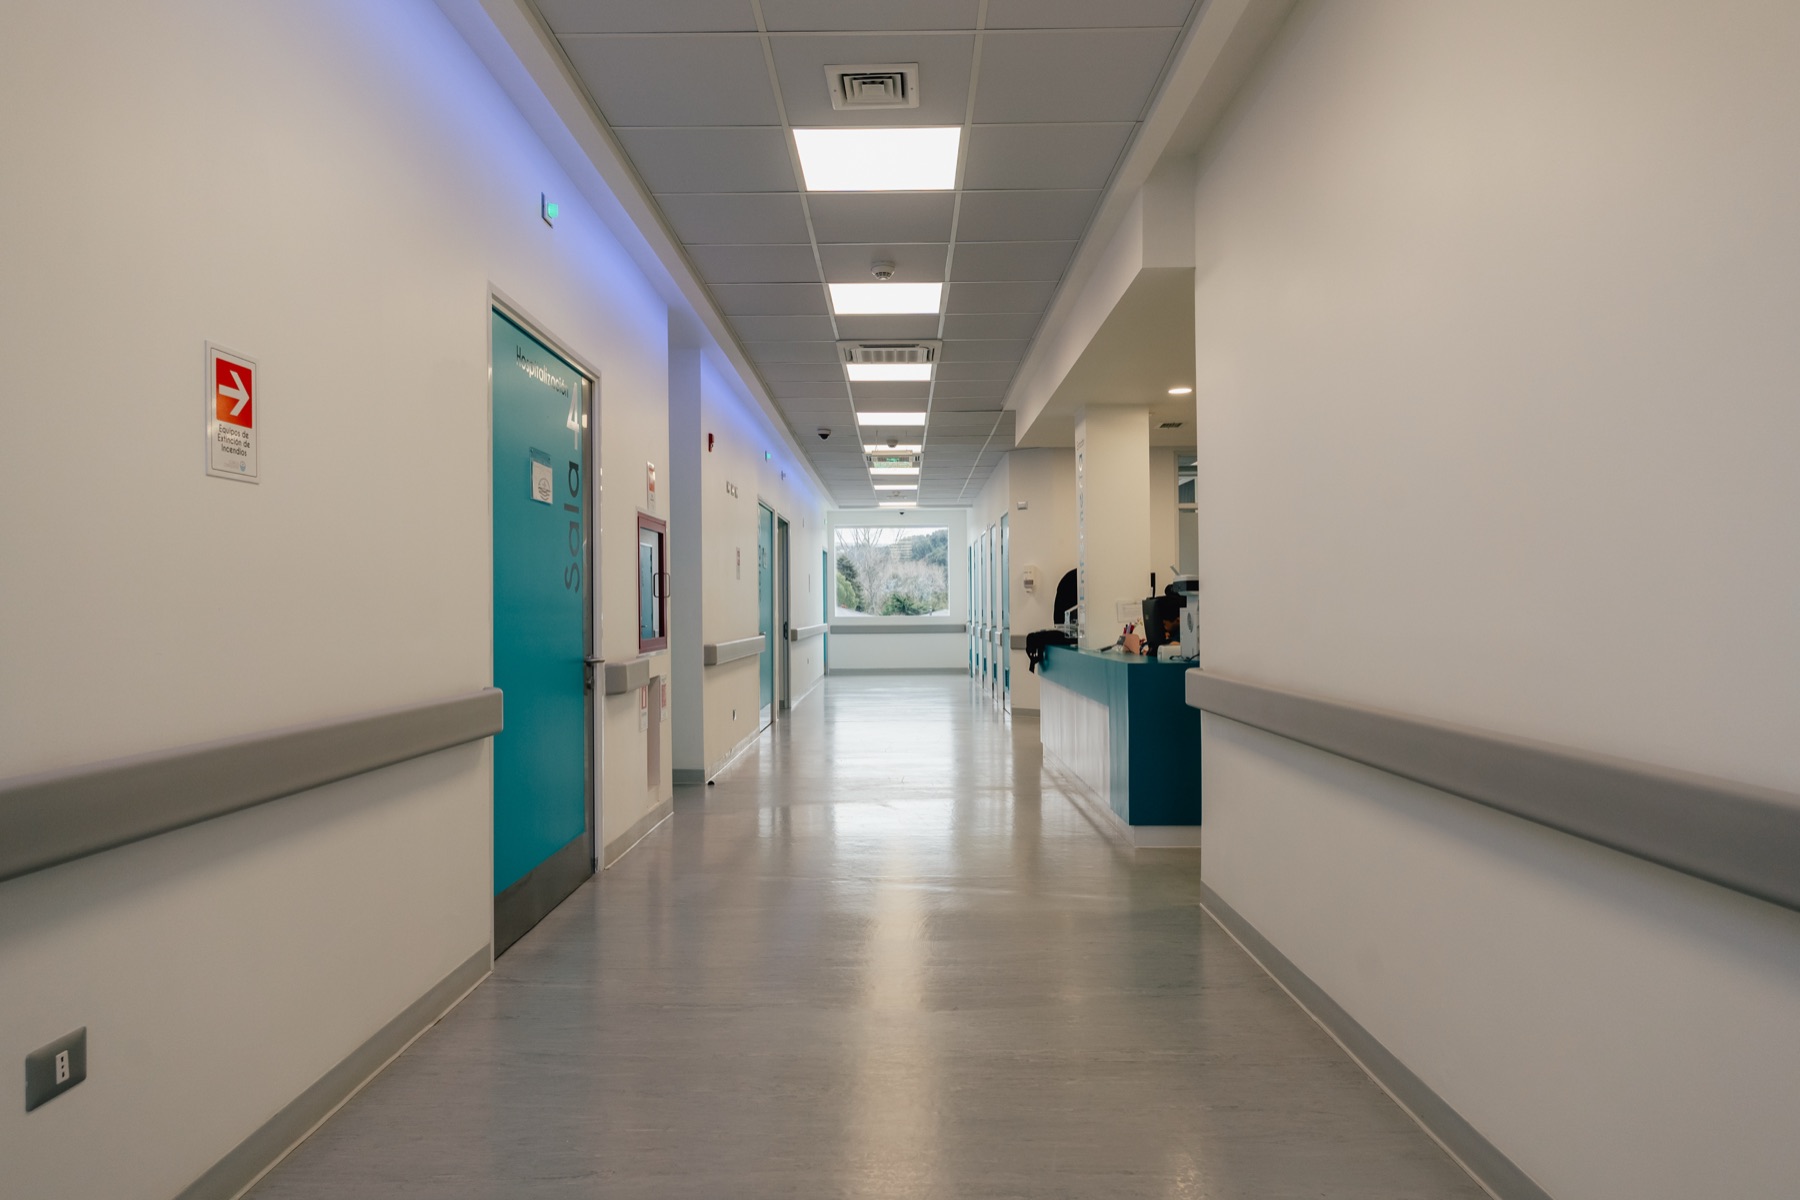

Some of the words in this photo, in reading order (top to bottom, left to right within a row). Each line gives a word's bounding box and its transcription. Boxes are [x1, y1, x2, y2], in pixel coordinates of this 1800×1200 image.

[516, 345, 569, 398] Hospitalización
[566, 382, 580, 450] 4
[219, 424, 240, 437] Equipos
[242, 431, 249, 439] de
[221, 443, 247, 456] Incendios
[243, 440, 250, 448] de
